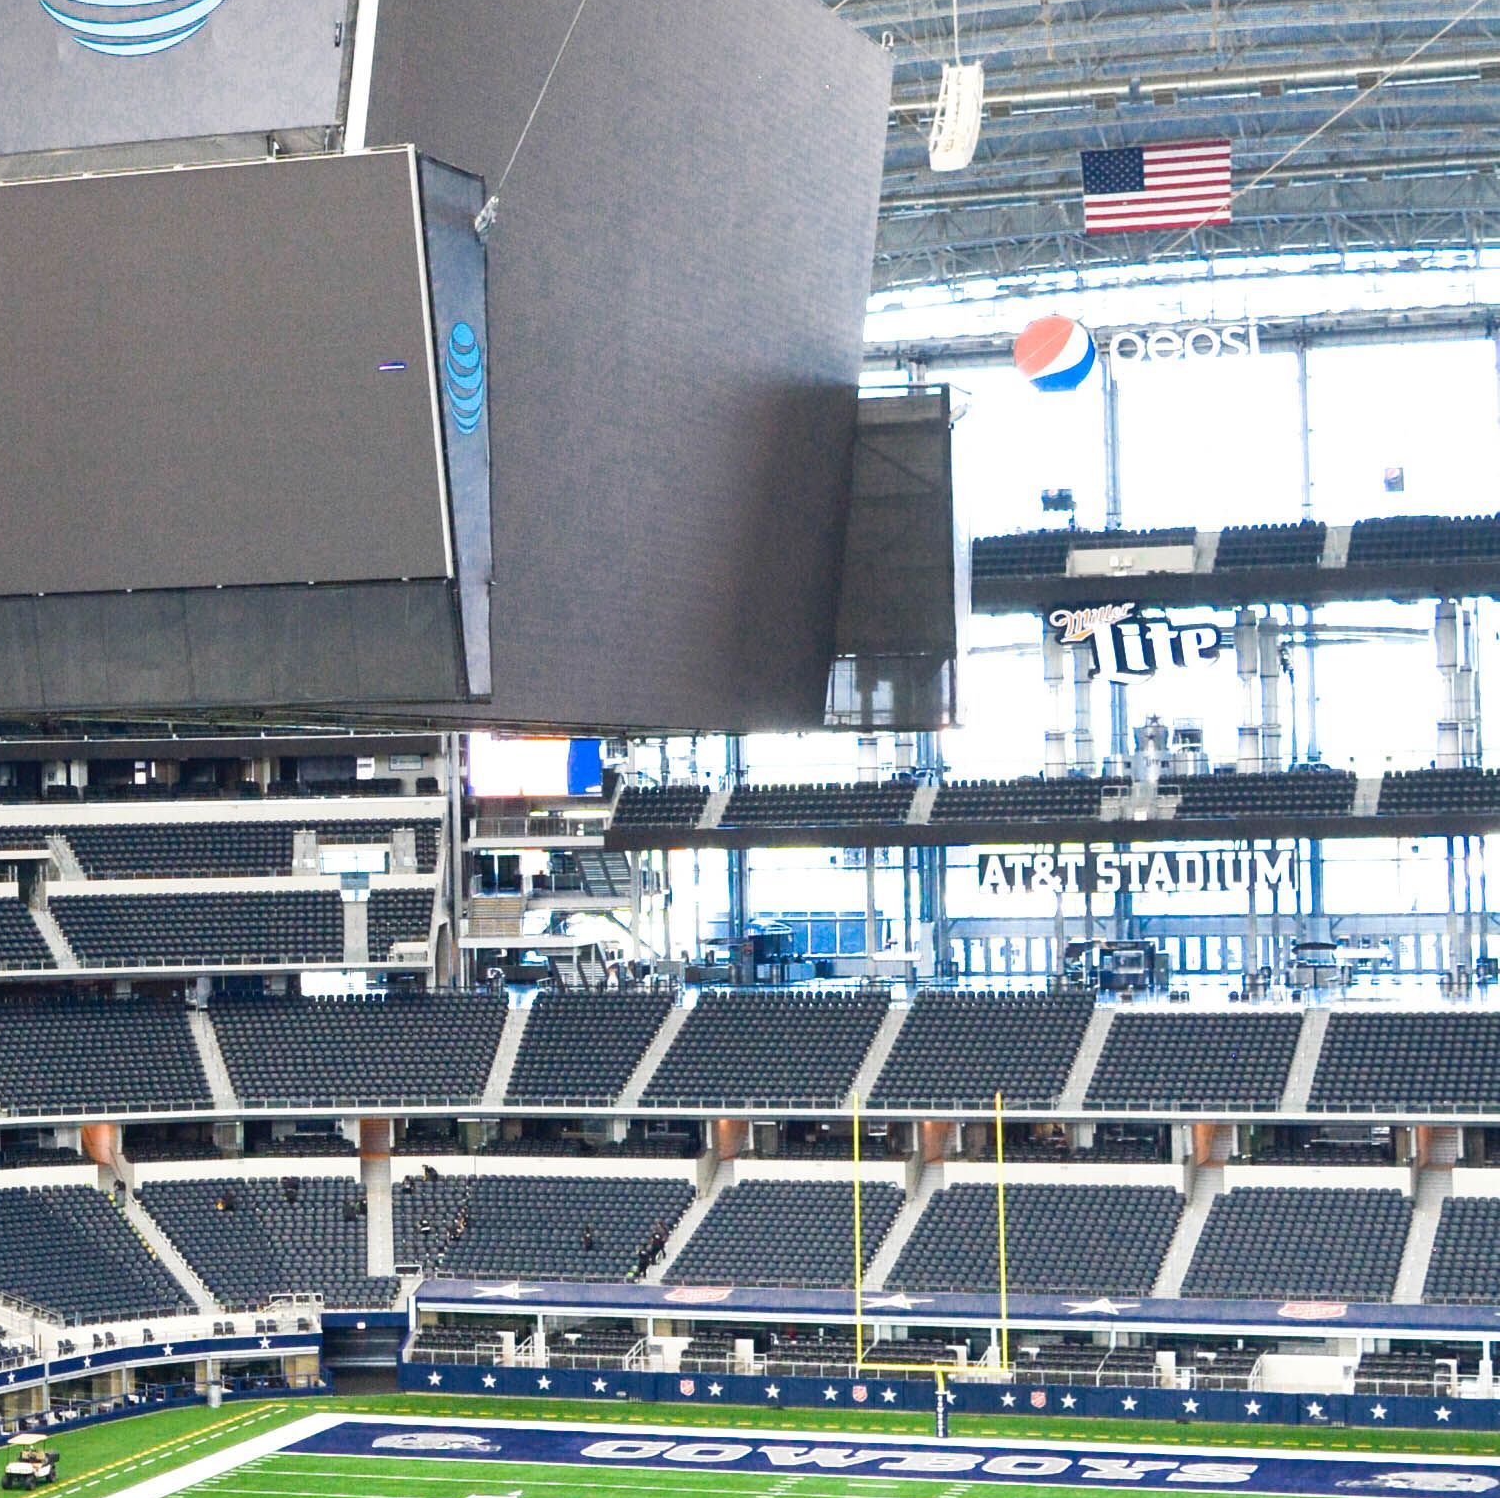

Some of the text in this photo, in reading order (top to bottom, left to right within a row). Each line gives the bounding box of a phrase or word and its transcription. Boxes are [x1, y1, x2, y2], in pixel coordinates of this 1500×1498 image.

[1092, 622, 1219, 685] Lite
[980, 850, 1298, 894] AT&T STADIUM
[580, 1440, 1259, 1485] COWBOYS
